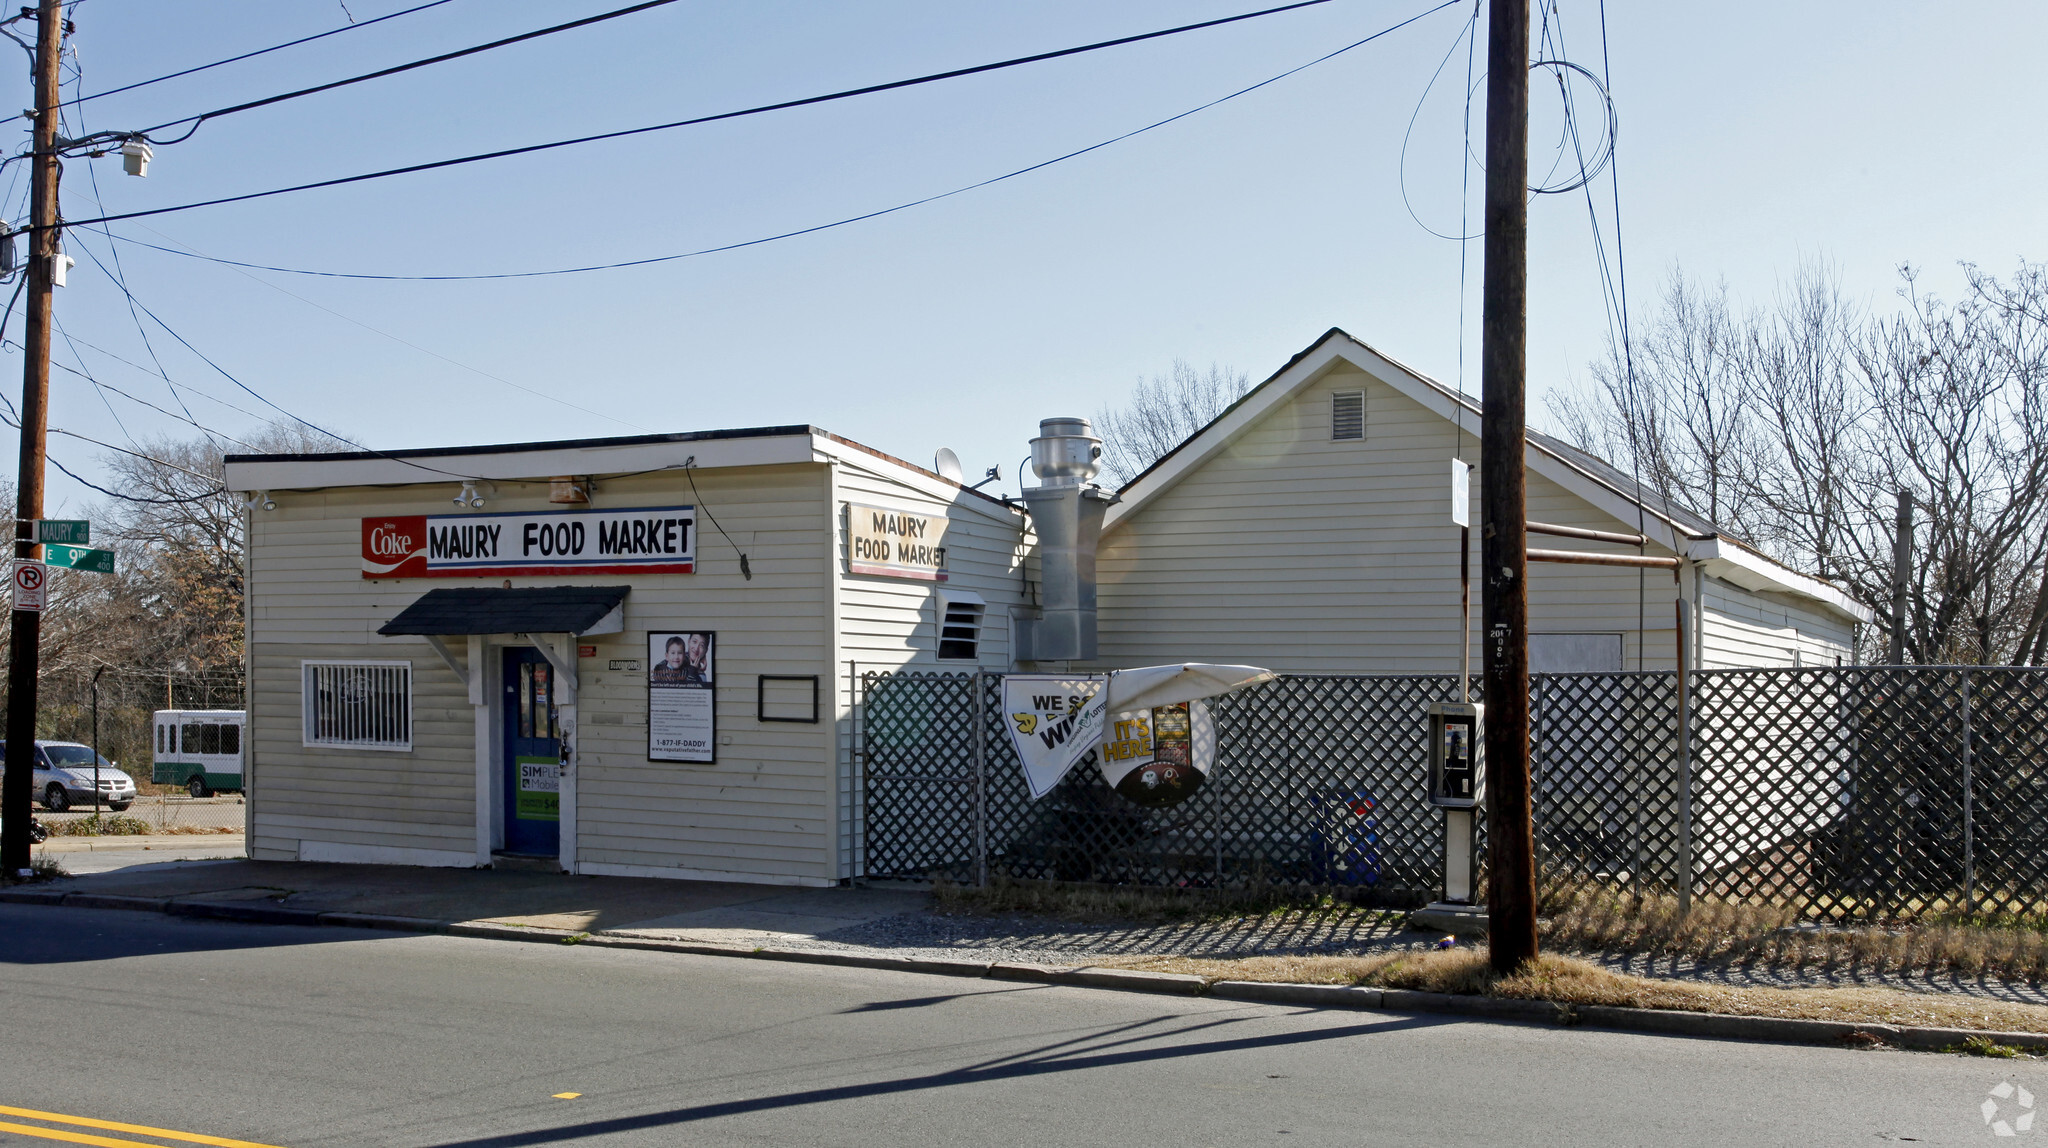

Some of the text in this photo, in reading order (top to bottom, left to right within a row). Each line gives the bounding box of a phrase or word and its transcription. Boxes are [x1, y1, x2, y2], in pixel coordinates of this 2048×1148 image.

[41, 523, 87, 541] MAURY ST
[384, 522, 396, 530] Enjoy
[873, 512, 927, 538] MAURY
[76, 533, 87, 542] 900
[371, 527, 412, 555] Coke
[429, 518, 693, 559] MAURY FOOD MARKET
[47, 549, 111, 566] E 9TH ST
[855, 536, 946, 567] FOOD MARKET
[97, 563, 111, 571] 400
[1032, 695, 1064, 711] WE
[1441, 705, 1465, 713] Phone
[1114, 717, 1150, 741] IT'S
[656, 739, 707, 747] 1-877-IF-DADDY
[1103, 737, 1153, 763] HERE
[522, 766, 559, 778] SIMPLE
[531, 779, 559, 790] Mobile
